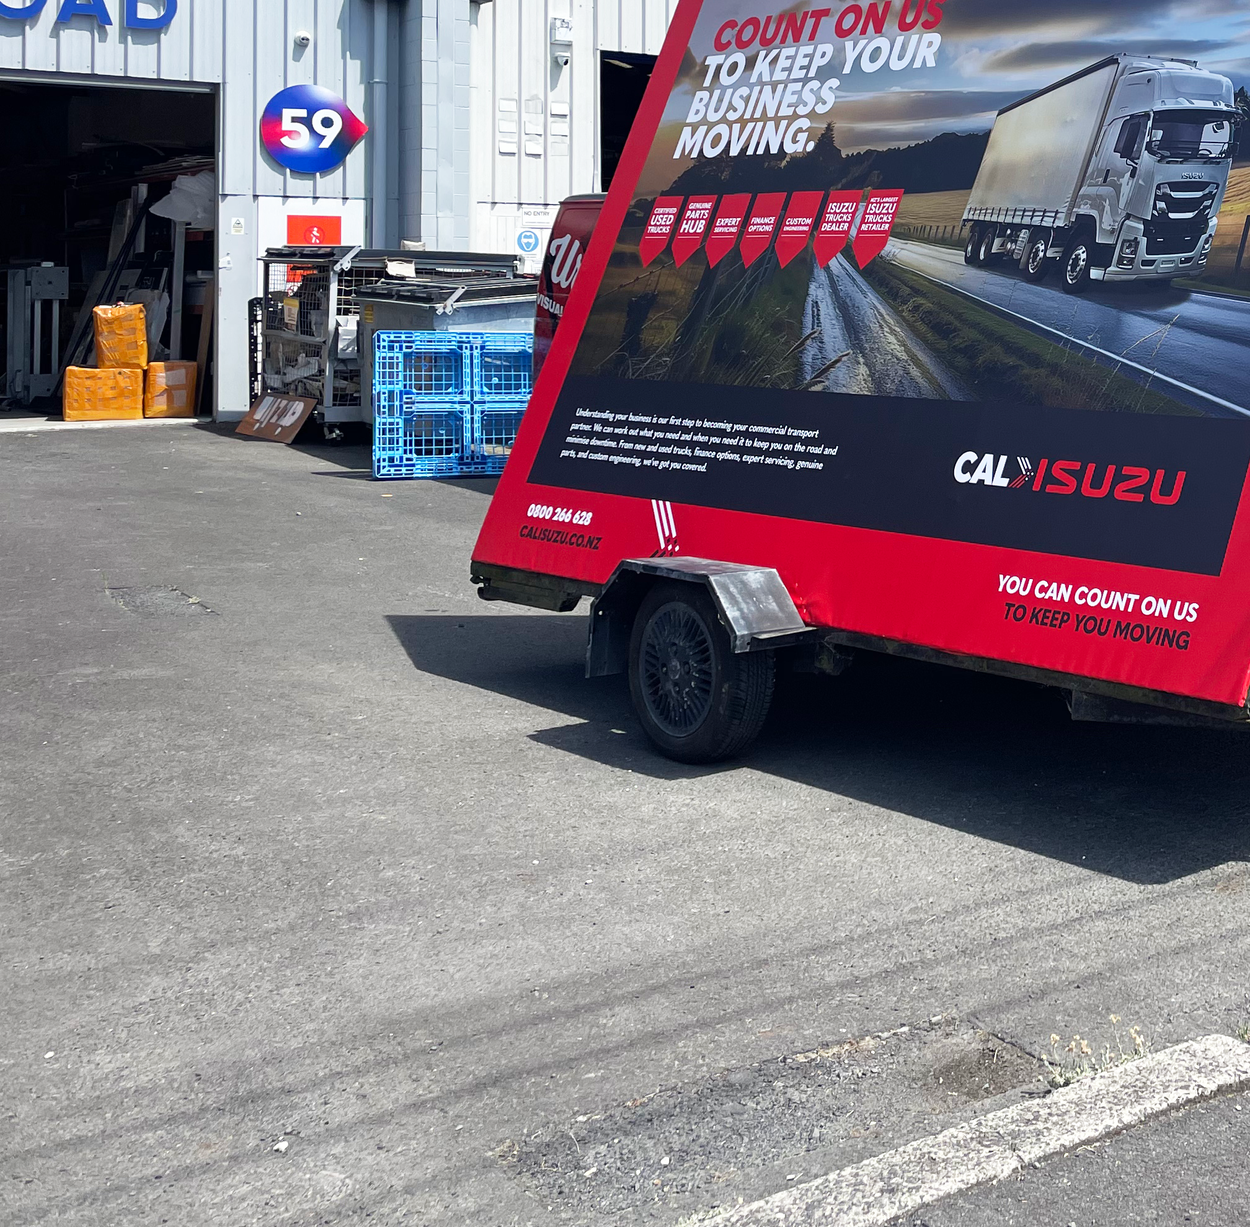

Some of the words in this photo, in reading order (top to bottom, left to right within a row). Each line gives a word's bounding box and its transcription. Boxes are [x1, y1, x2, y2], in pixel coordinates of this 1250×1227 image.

[713, 8, 831, 52] COUNT
[834, 0, 892, 39] ON
[702, 52, 746, 87] TO
[750, 43, 834, 83] KEEP
[841, 32, 942, 74] YOUR
[685, 78, 841, 123] BUSINESS
[279, 108, 343, 149] 59
[672, 117, 816, 159] MOVING.
[685, 210, 710, 219] PARTS
[825, 214, 852, 222] TRUCKS
[827, 202, 856, 212] ISUZU
[864, 214, 892, 222] TRUCKS
[867, 203, 896, 214] ISUZU
[648, 226, 670, 234] TRUCKS
[650, 214, 674, 225] USED
[680, 220, 706, 233] HUB
[716, 218, 742, 226] EXPERT
[748, 224, 774, 232] OPTIONS
[750, 216, 776, 224] FINANCE
[821, 223, 850, 231] DEALER
[576, 408, 614, 422] Understanding
[614, 413, 628, 422] your
[628, 412, 652, 422] business
[652, 414, 658, 424] is
[669, 416, 682, 426] first
[682, 418, 695, 428] step
[696, 419, 702, 427] to
[703, 418, 732, 432] becoming
[732, 424, 748, 432] your
[749, 425, 787, 435] commercial
[787, 428, 820, 439] transport
[593, 422, 602, 432] We
[614, 426, 628, 434] work
[629, 428, 639, 436] out
[639, 428, 654, 437] what
[652, 431, 665, 440] you
[665, 430, 681, 440] need
[680, 432, 693, 440] and
[693, 432, 708, 442] when
[708, 436, 721, 445] you
[722, 436, 739, 446] need
[739, 437, 744, 446] it
[745, 438, 752, 447] to
[753, 438, 769, 450] keep
[769, 443, 784, 451] you
[794, 442, 806, 452] the
[806, 444, 824, 454] road
[824, 446, 838, 456] and
[560, 449, 576, 458] parts,
[577, 450, 590, 458] and
[588, 452, 608, 460] custom
[643, 456, 660, 466] we've
[658, 460, 670, 470] got
[669, 462, 682, 470] you
[682, 462, 708, 472] covered.
[566, 434, 590, 444] minimise
[618, 439, 634, 448] From
[646, 443, 659, 452] and
[658, 445, 674, 454] used
[673, 446, 692, 457] trucks,
[694, 446, 716, 458] finance
[716, 450, 740, 462] options,
[742, 455, 764, 464] expert
[764, 456, 795, 469] servicing,
[796, 459, 824, 470] genuine
[953, 451, 1010, 488] CAL
[1032, 458, 1187, 506] ISUZU
[527, 503, 554, 520] 0800
[552, 507, 573, 523] 266
[572, 510, 593, 526] 628
[519, 524, 602, 550] CALISUZU.CO.NZ
[997, 574, 1033, 596] YOU
[1034, 580, 1072, 602] CAN
[1074, 586, 1140, 613] COUNT
[1141, 596, 1172, 618] ON
[1173, 600, 1200, 622] US
[1004, 602, 1026, 622] TO
[1028, 606, 1070, 630] KEEP
[1074, 614, 1112, 636] YOU
[1112, 620, 1192, 650] MOVING
